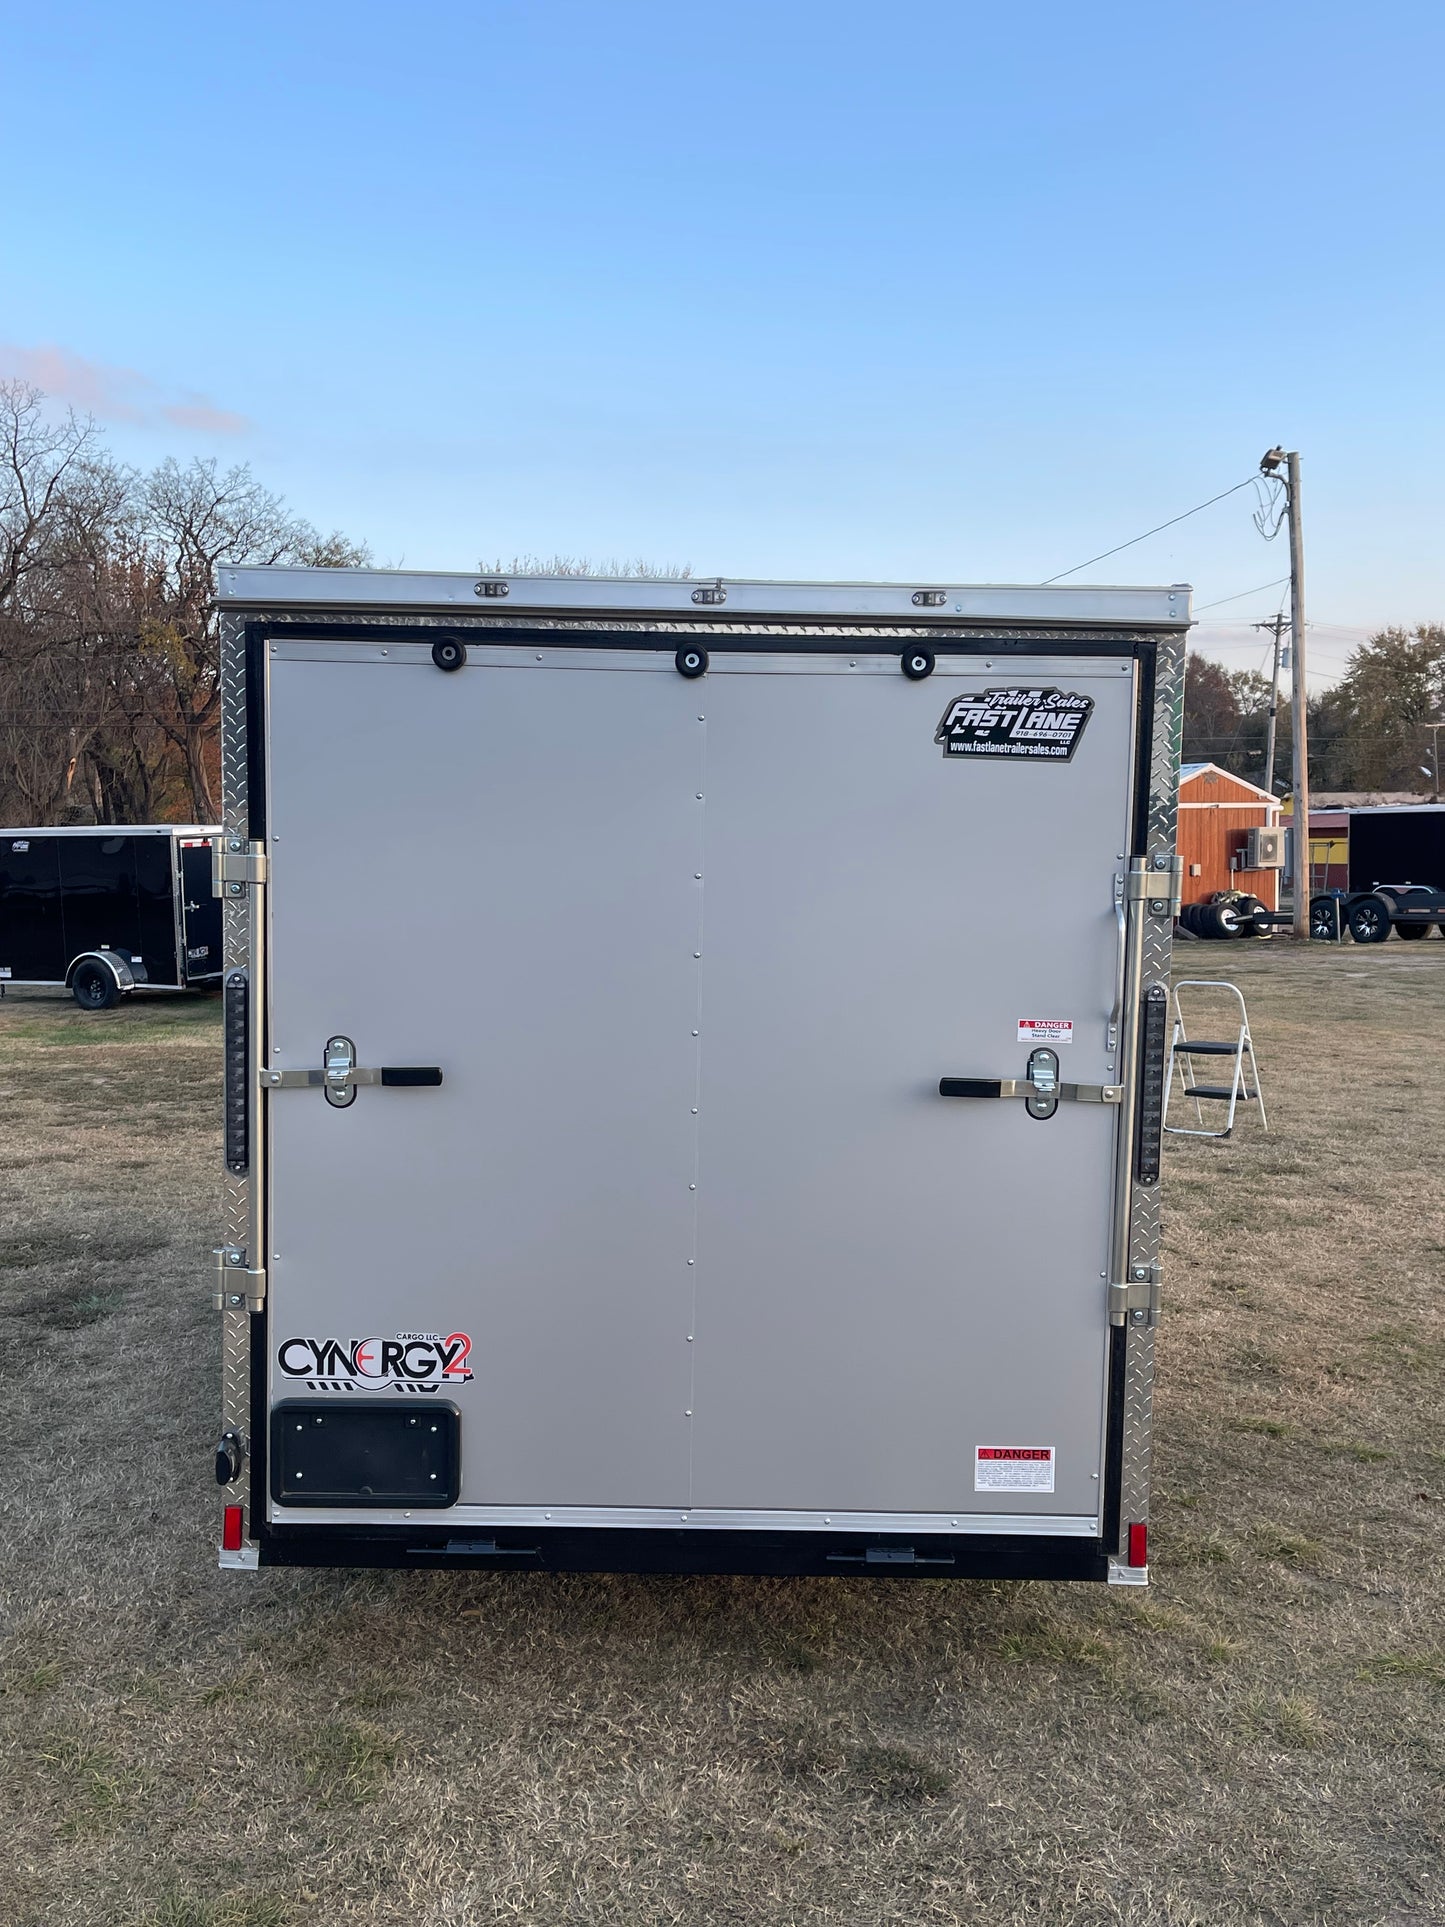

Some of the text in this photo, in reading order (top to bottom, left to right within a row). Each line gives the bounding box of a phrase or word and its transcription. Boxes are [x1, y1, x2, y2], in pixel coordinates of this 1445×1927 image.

[988, 691, 1089, 709] Trailer Sales
[1015, 730, 1072, 738] 918-696-0701
[950, 740, 1068, 756] www.fastlanetrailersales.com
[396, 1333, 424, 1341] CARGO
[993, 1449, 1050, 1460] DANGER
